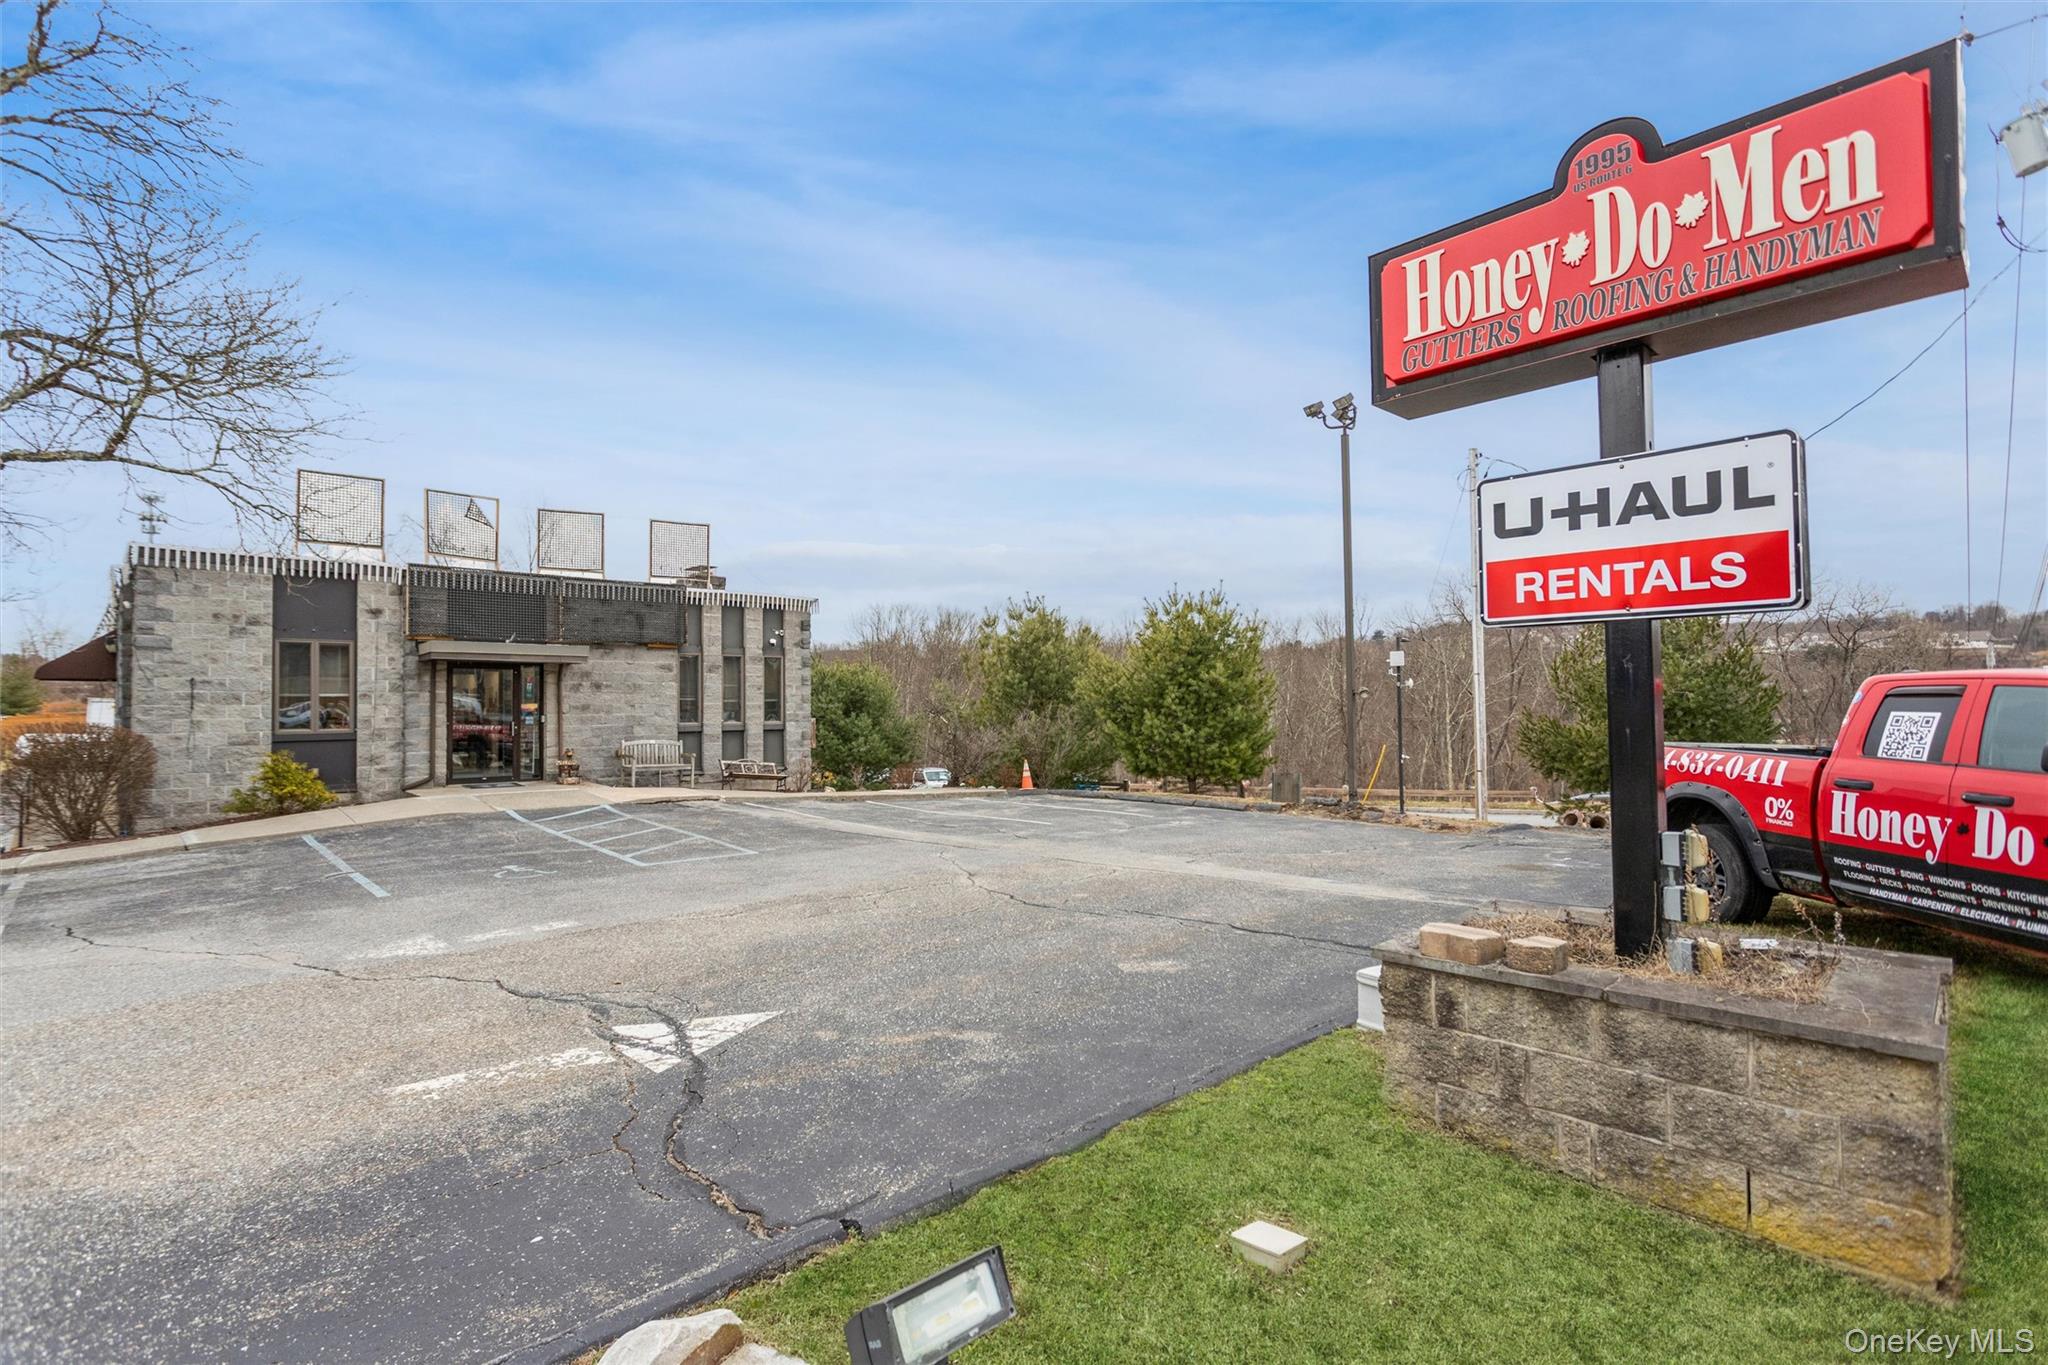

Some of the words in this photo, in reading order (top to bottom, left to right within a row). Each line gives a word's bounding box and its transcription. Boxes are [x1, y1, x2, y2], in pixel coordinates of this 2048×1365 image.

[1573, 181, 1587, 193] US
[1590, 168, 1623, 188] ROUTE
[1574, 141, 1632, 179] 1995
[1401, 237, 1560, 334] Honey
[1587, 186, 1673, 286] Do
[1700, 124, 1884, 250] Men
[1402, 313, 1523, 373] GUTTERS
[1551, 267, 1675, 333] ROOFING
[1678, 263, 1698, 298] &
[1702, 206, 1884, 291] HANDYMAN
[1514, 551, 1748, 604] RENTALS
[1764, 796, 1795, 821] 0%
[1829, 789, 1953, 865] Honey
[1971, 805, 2035, 867] Do
[1833, 856, 1862, 869] ROOFING
[1865, 863, 1896, 875] GUTTERS
[1900, 870, 1924, 882] SIDING
[1929, 875, 1966, 890] WINDOWS
[1971, 883, 2001, 897] DOORS
[1843, 870, 1876, 883] FLOORING
[1879, 877, 1903, 889] DECKS
[1906, 883, 1933, 896] PATIOS
[1937, 889, 1977, 905] CHIMNEYS
[1981, 898, 2031, 916] DRIVEWAYS
[1869, 887, 1908, 903] HANDYMAN
[1911, 897, 1957, 914] CARPENTRY
[1960, 907, 2010, 927] ELECTRICAL
